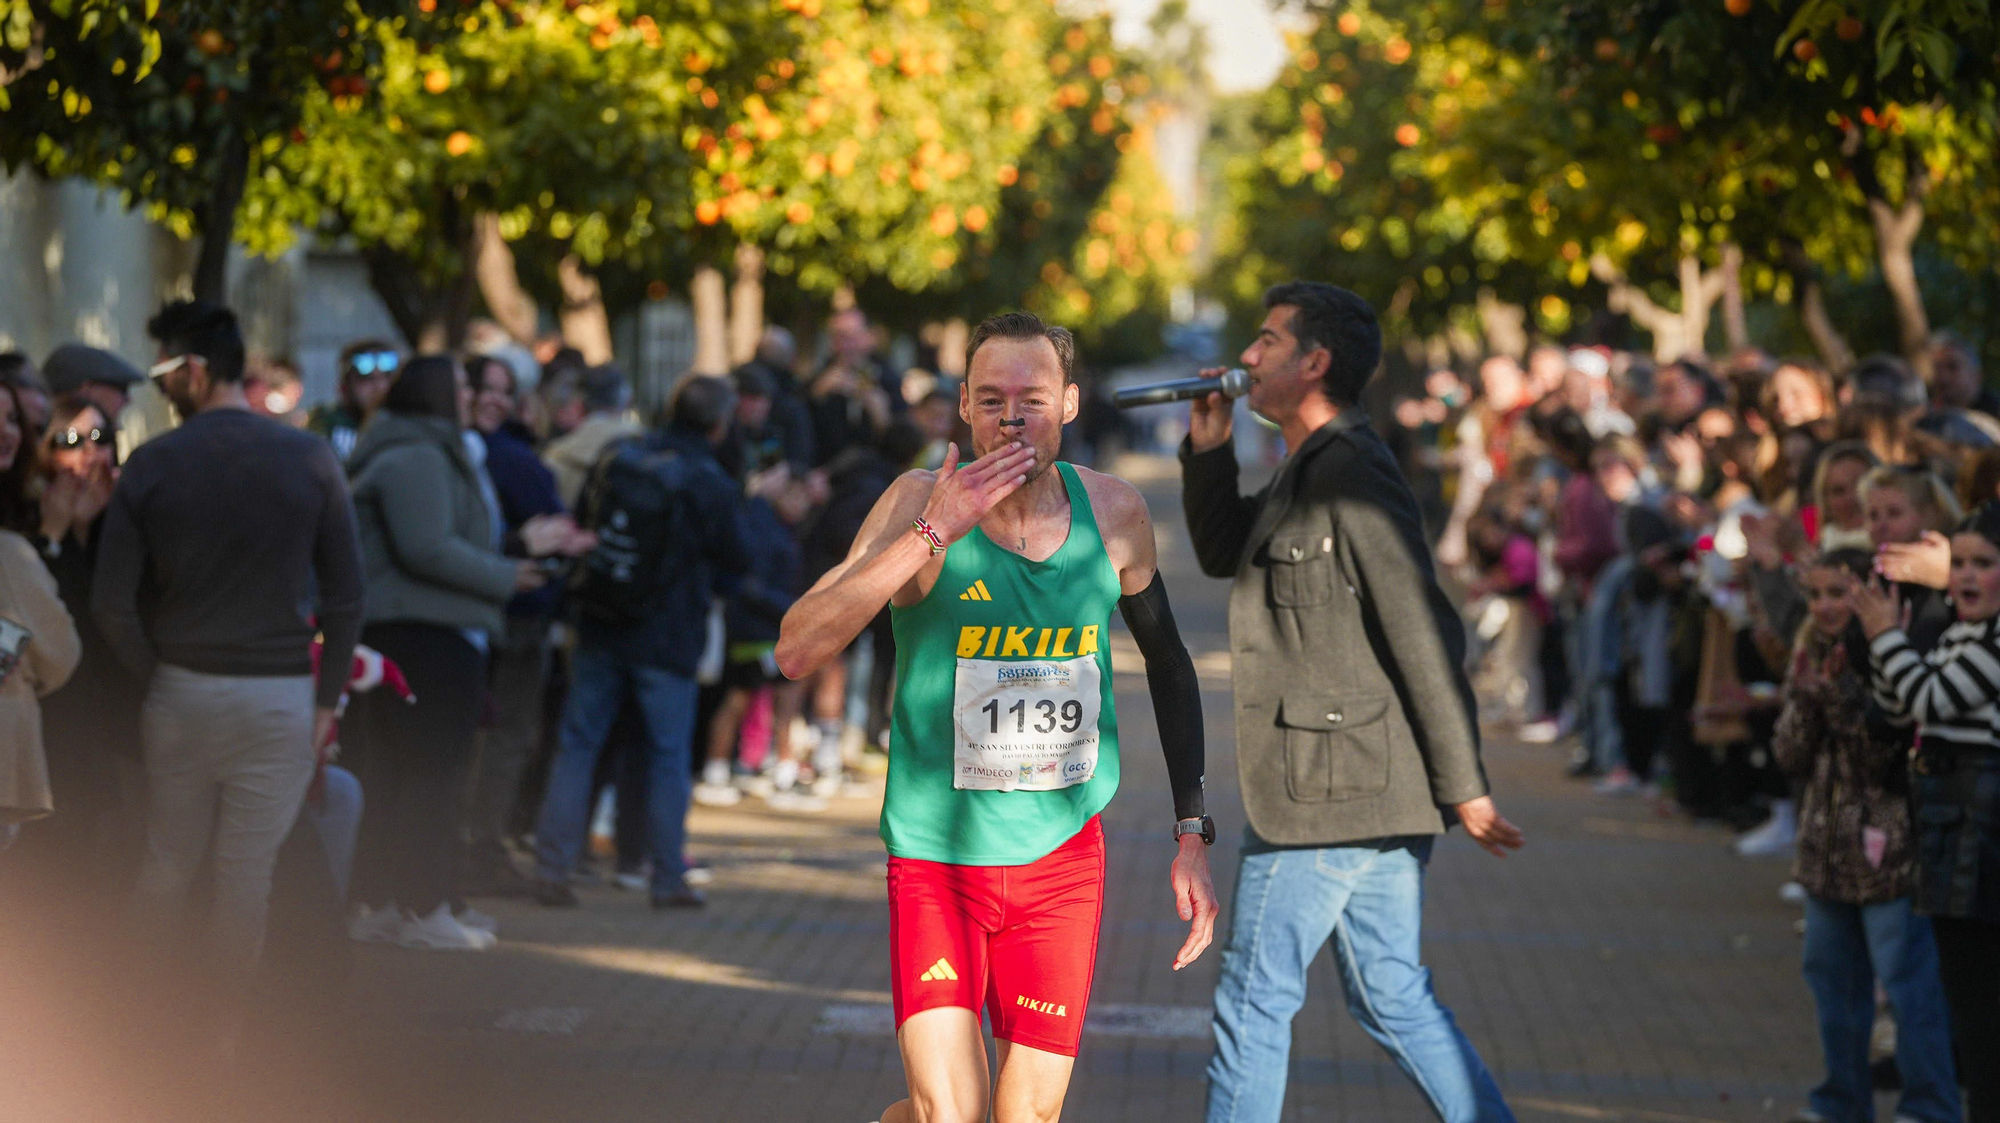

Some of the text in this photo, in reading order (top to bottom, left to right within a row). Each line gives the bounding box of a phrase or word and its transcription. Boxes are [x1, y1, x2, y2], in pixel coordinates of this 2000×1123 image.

[956, 624, 1099, 658] BIKILA
[982, 699, 1083, 734] 1139
[1049, 738, 1096, 750] CORDOBESA
[973, 766, 1013, 778] IMDECO
[1068, 762, 1087, 773] GCC
[1016, 994, 1067, 1017] BIKILA
